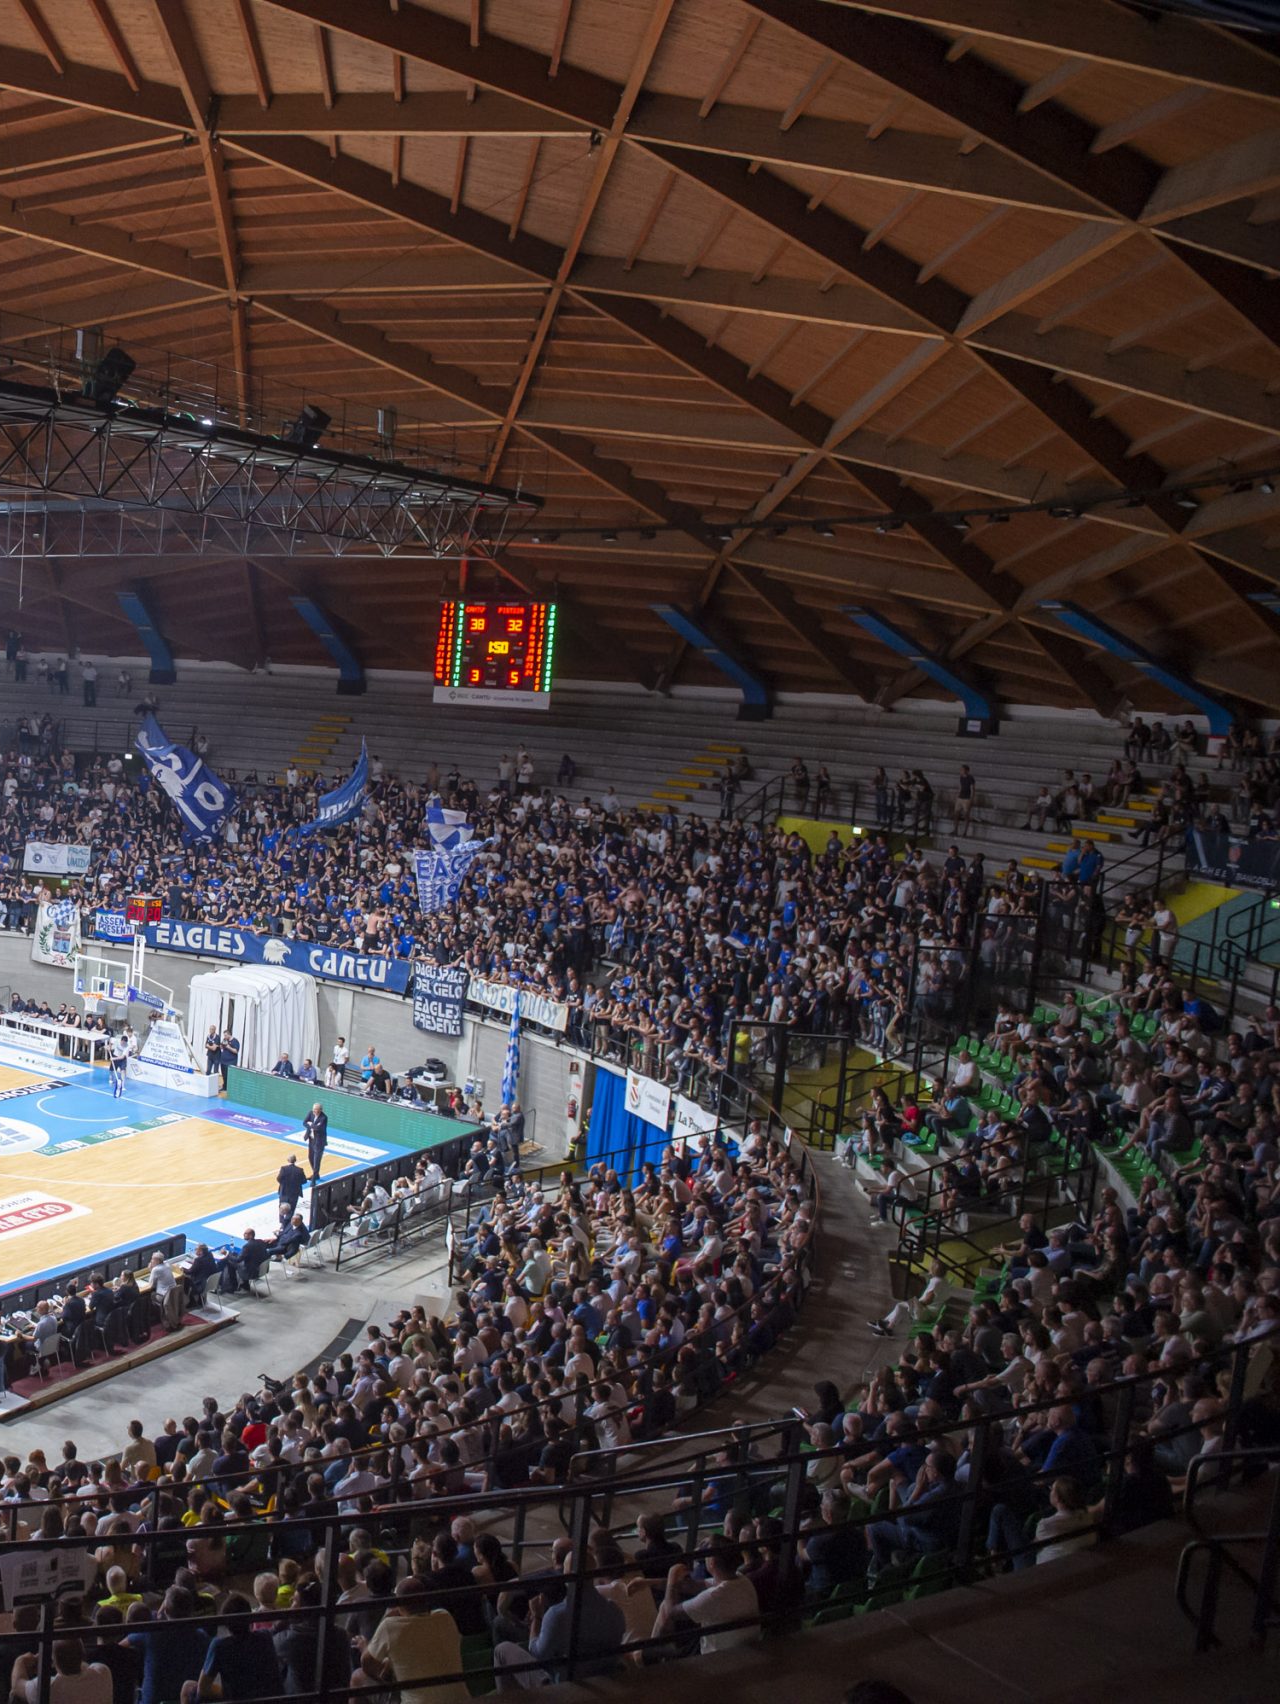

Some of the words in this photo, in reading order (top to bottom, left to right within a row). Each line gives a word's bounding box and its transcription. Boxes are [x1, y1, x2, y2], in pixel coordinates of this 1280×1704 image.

[470, 618, 485, 631] 38
[507, 619, 523, 632] 32
[471, 669, 480, 682] 3
[510, 671, 519, 684] 5
[99, 914, 125, 926] ASSEN
[156, 924, 245, 956] EAGLES
[414, 997, 461, 1019] EAGLES
[413, 1011, 462, 1036] PRESENTI
[27, 1203, 65, 1222] OLD
